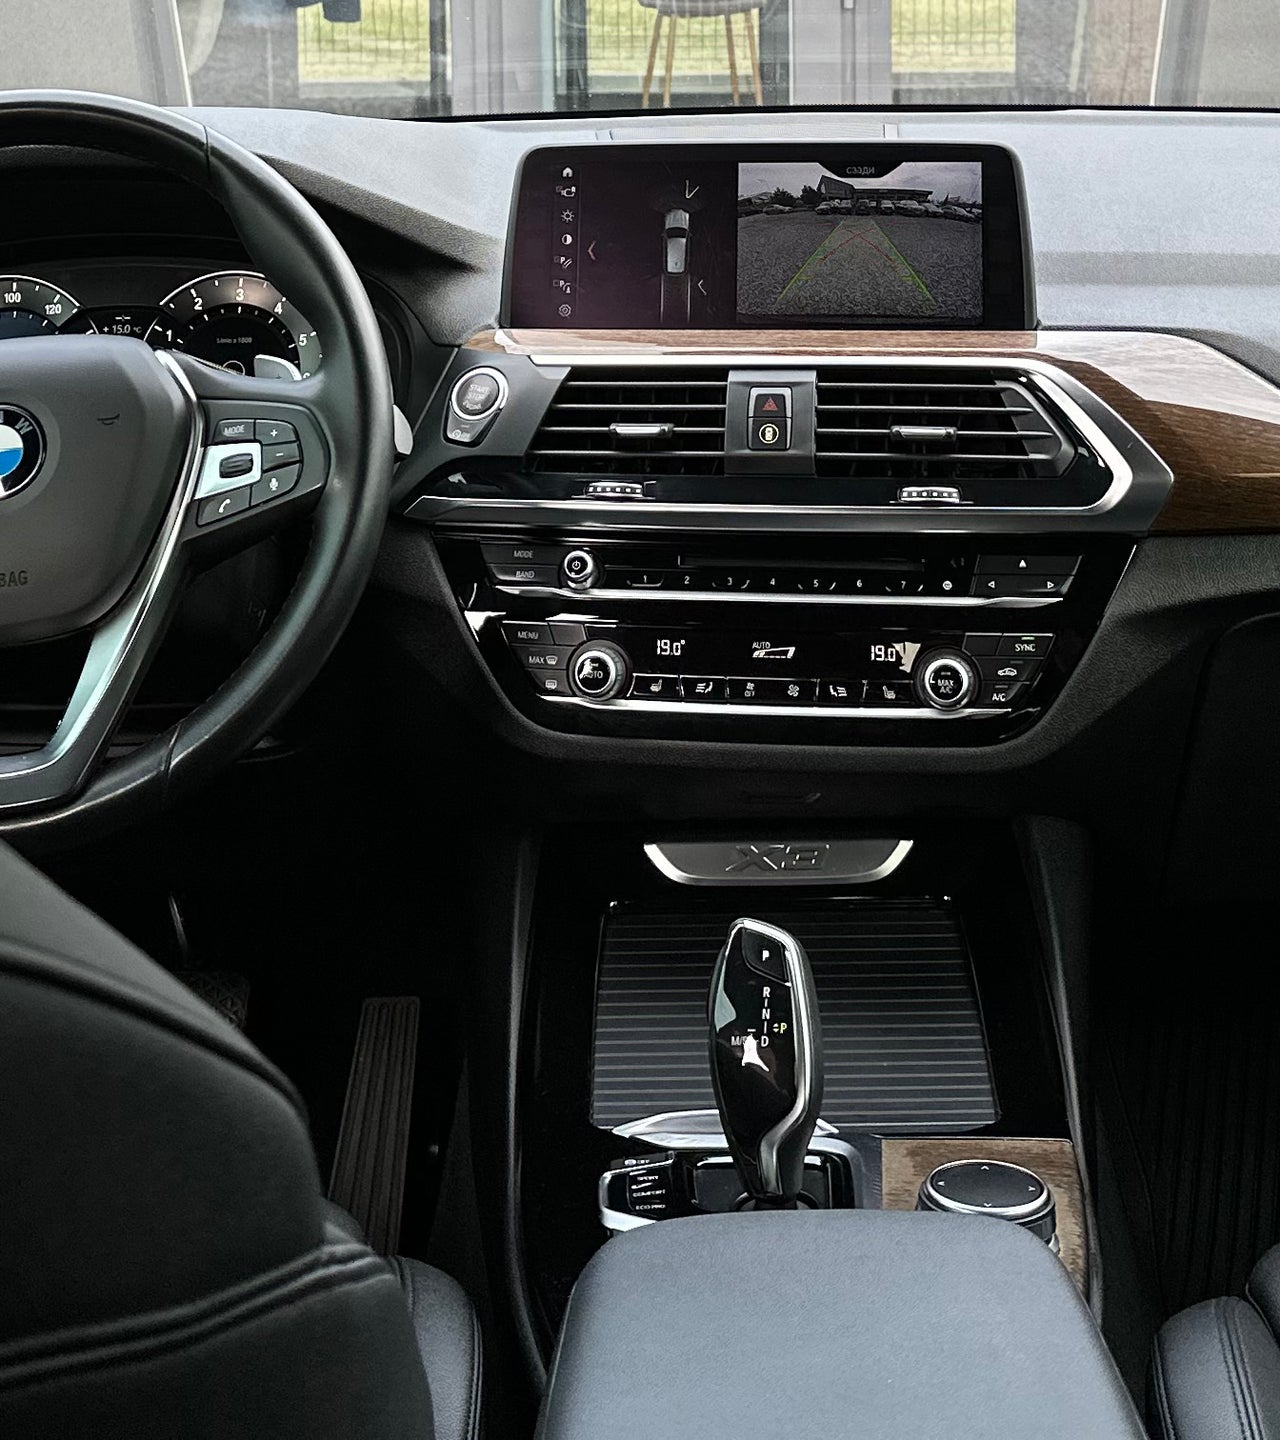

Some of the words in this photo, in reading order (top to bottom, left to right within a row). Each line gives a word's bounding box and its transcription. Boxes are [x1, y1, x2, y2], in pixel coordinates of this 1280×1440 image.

[3, 292, 22, 303] 100
[235, 288, 245, 301] 3
[193, 298, 203, 310] 2
[273, 302, 283, 315] 4
[44, 303, 62, 315] 120
[112, 324, 131, 334] 15.0
[165, 329, 173, 341] 1
[298, 333, 308, 346] 5
[223, 424, 245, 434] MODE
[513, 550, 534, 558] MODE
[515, 570, 535, 579] BAND
[684, 576, 690, 585] 2
[727, 577, 733, 586] 3
[769, 578, 776, 586] 4
[813, 579, 819, 588] 5
[856, 579, 862, 588] 6
[900, 581, 907, 589] 7
[517, 631, 539, 640] MENU
[752, 641, 771, 649] AUTO
[1014, 643, 1036, 652] SYNC
[528, 656, 545, 665] MAX
[937, 679, 954, 687] MAX
[991, 693, 1006, 702] A/C
[762, 949, 770, 961] P
[762, 986, 771, 998] R
[762, 1008, 770, 1020] N
[780, 1022, 788, 1034] P
[761, 1035, 770, 1047] D
